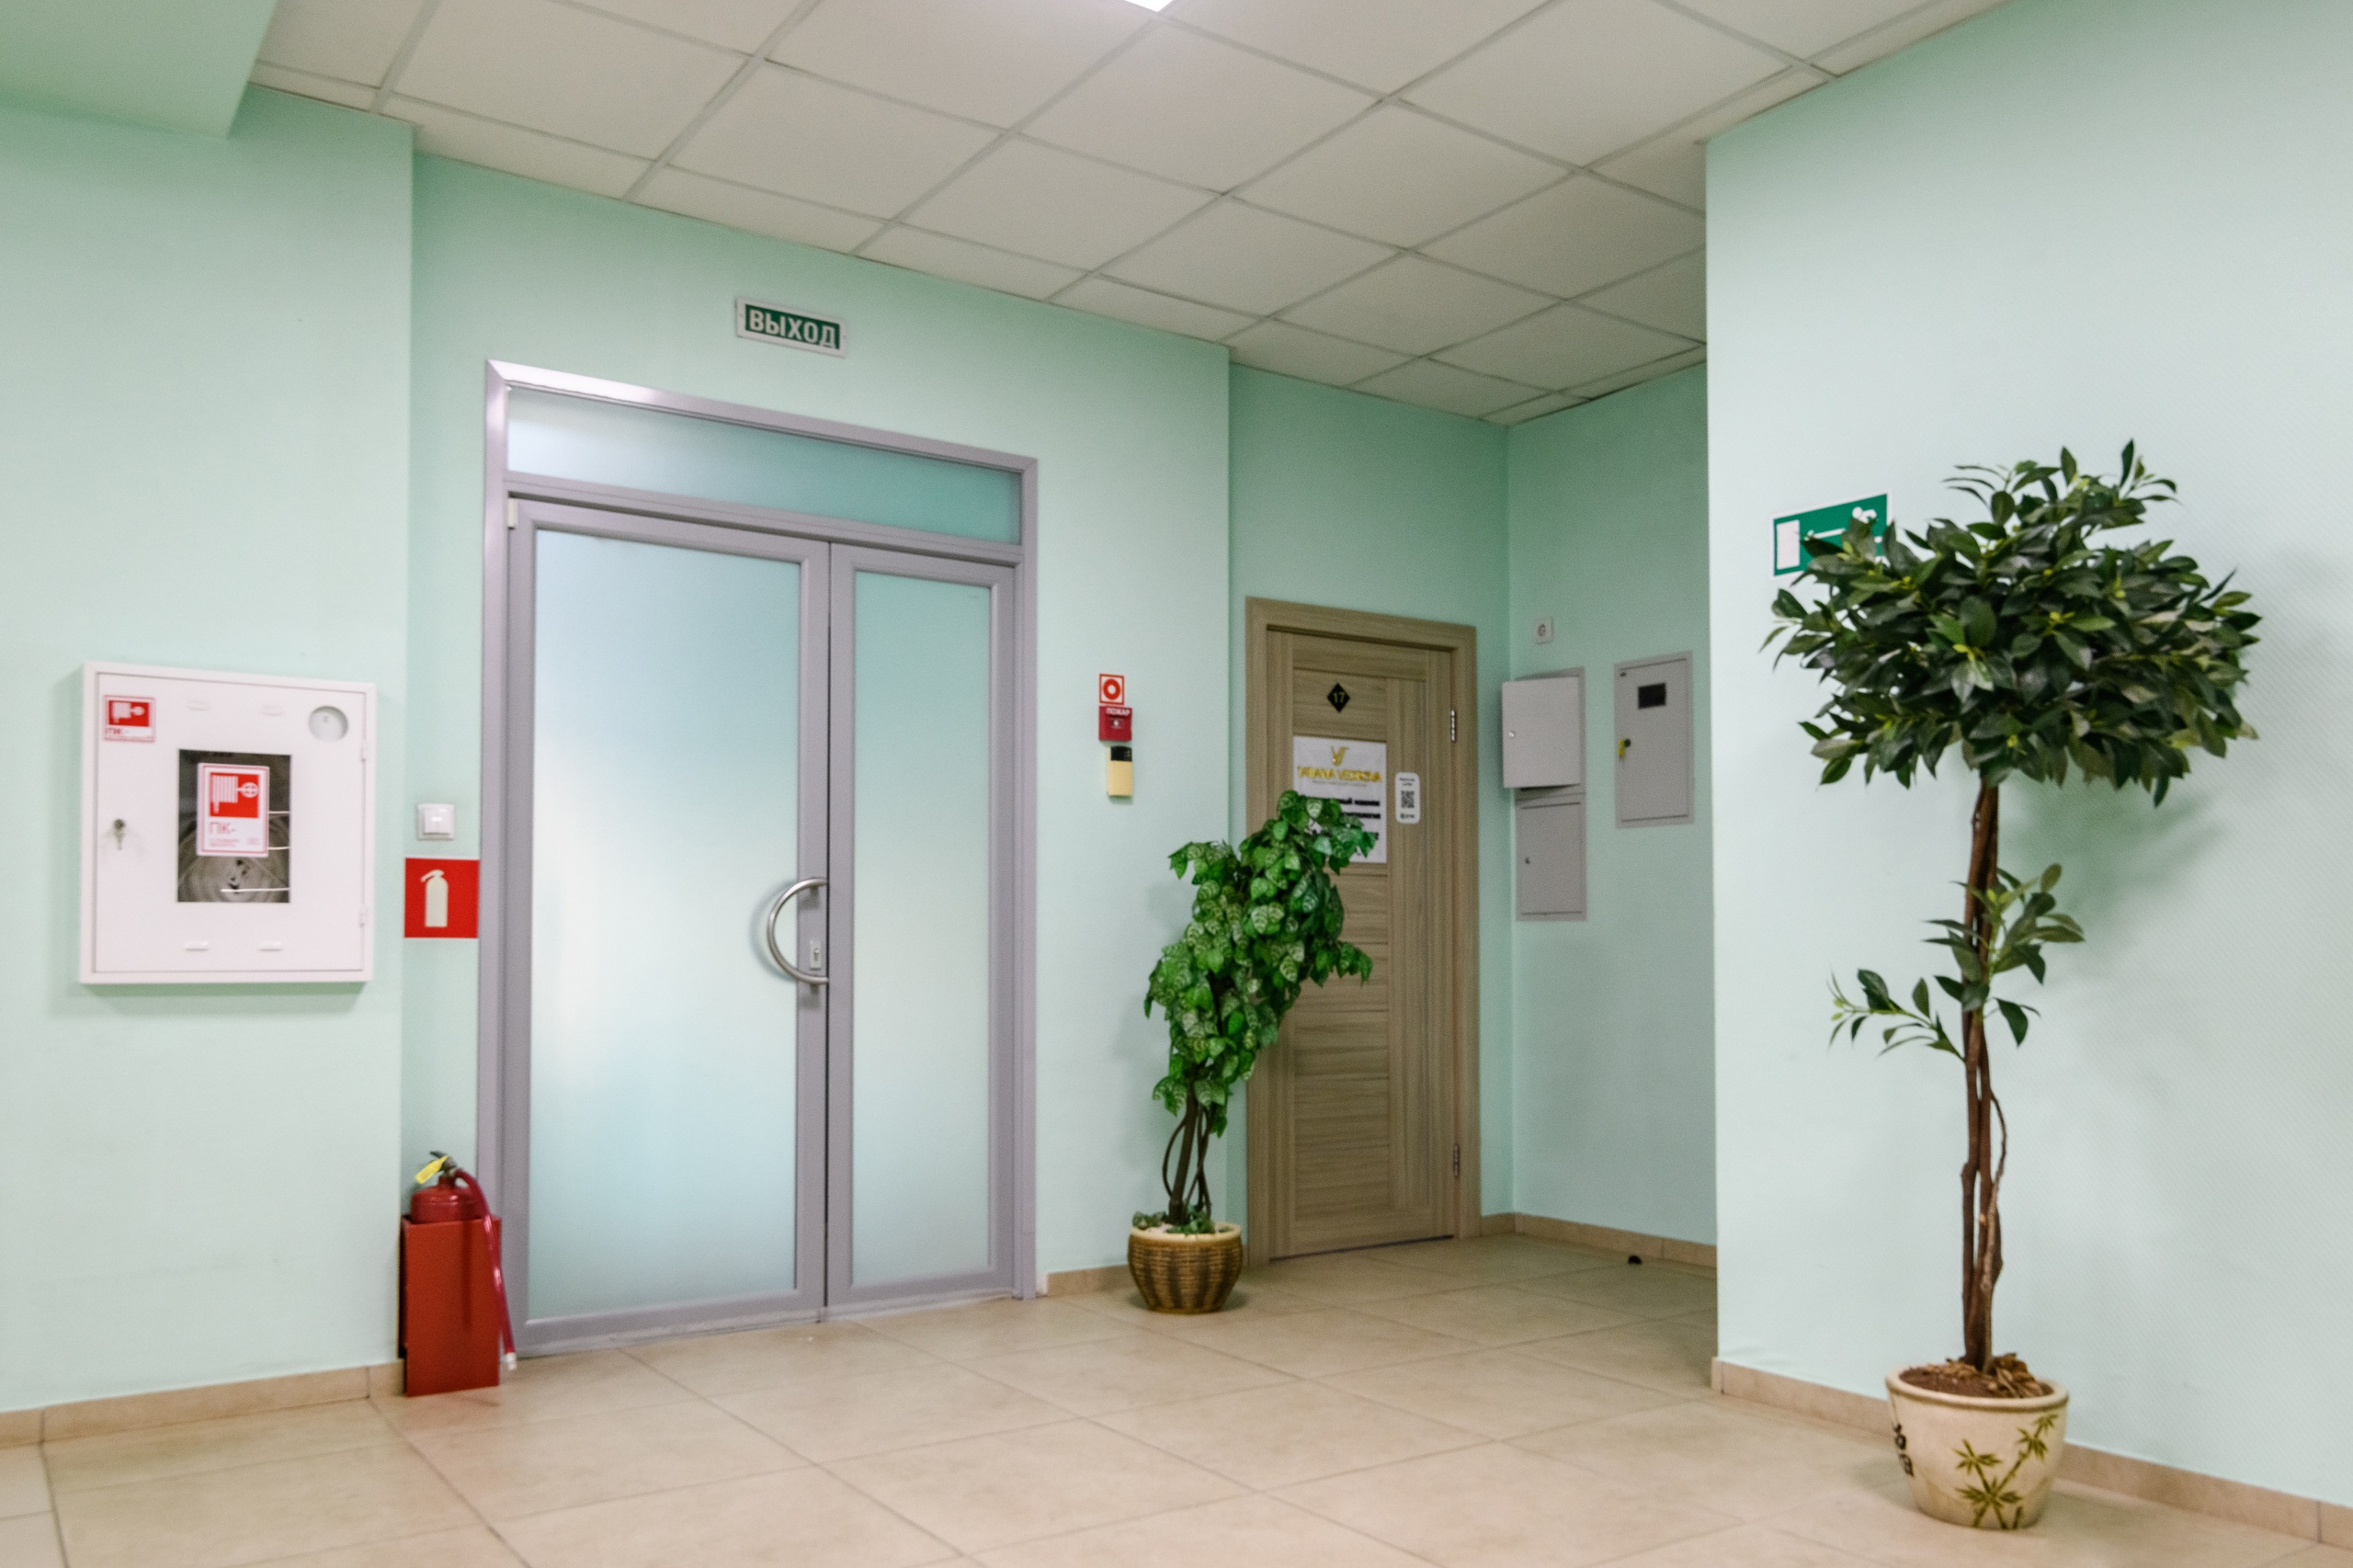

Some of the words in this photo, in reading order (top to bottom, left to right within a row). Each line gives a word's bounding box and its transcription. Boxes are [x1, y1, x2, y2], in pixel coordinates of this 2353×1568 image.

[749, 310, 836, 349] ВЫХОД
[1334, 691, 1346, 703] 17
[1106, 707, 1131, 716] ПОЖАР
